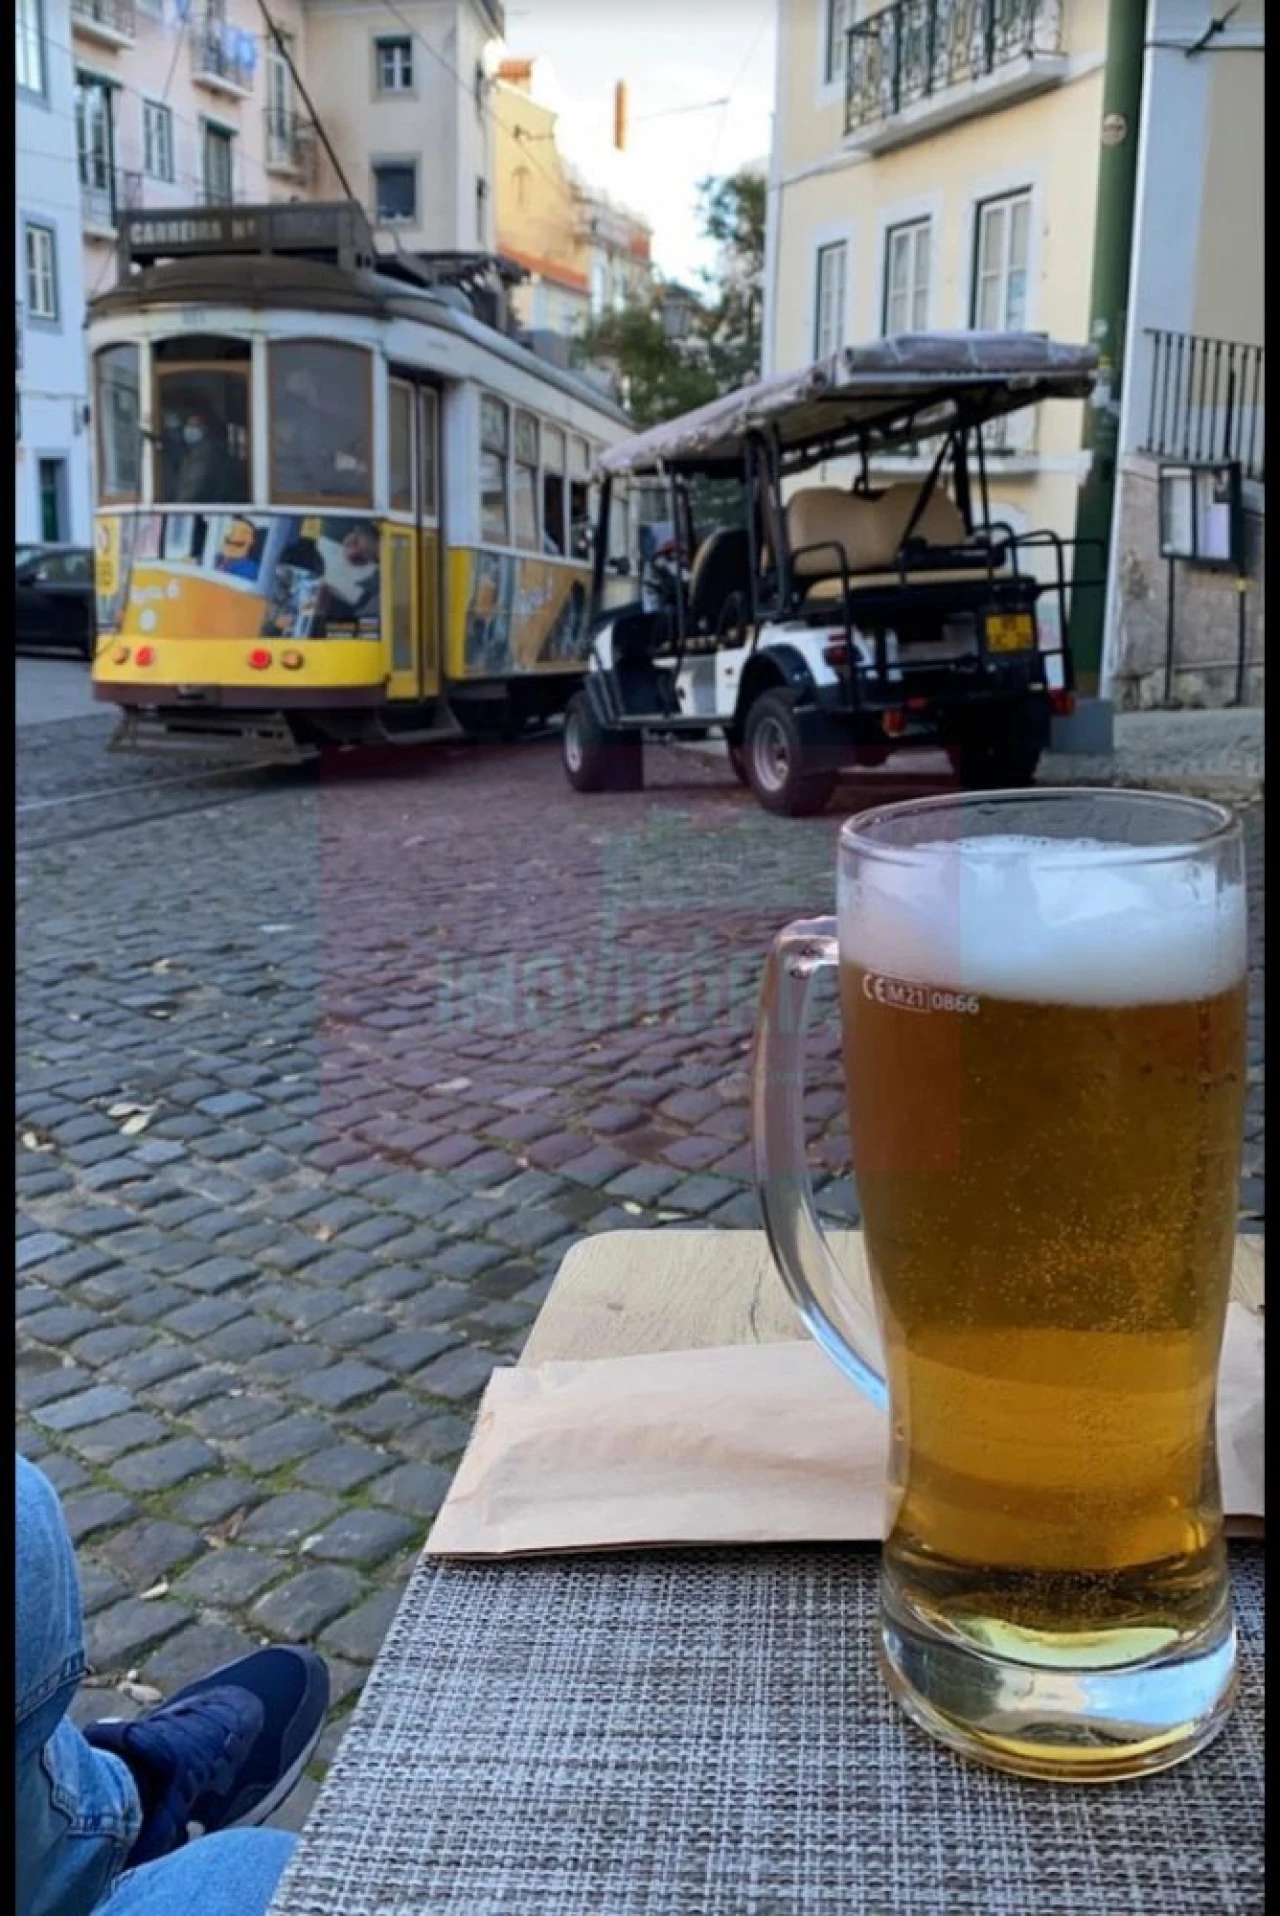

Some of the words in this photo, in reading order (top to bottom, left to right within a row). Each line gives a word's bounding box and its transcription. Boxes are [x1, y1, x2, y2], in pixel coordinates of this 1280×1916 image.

[130, 219, 223, 245] CARREIRA
[888, 983, 925, 1007] M21
[932, 990, 980, 1015] 0866
